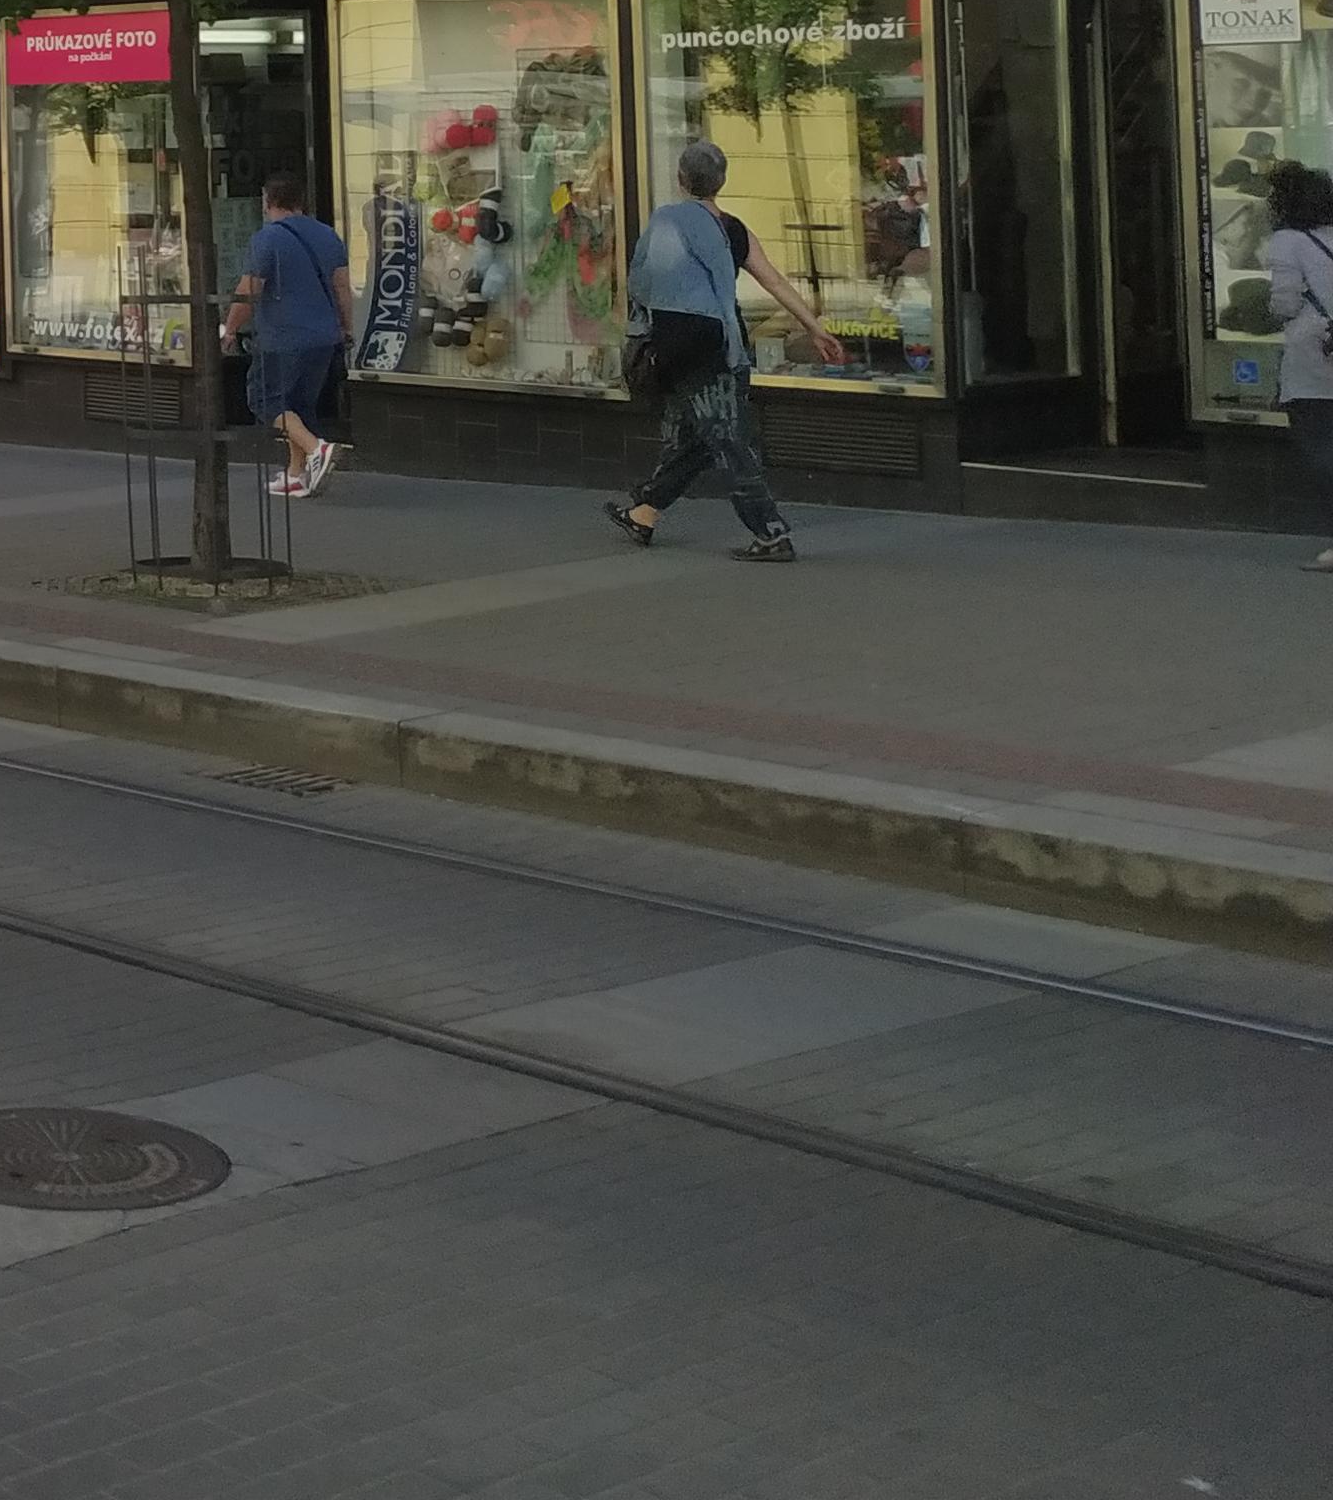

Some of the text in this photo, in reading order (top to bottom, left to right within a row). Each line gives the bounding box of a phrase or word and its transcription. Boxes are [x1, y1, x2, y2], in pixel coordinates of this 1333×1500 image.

[1205, 8, 1293, 28] TONAK
[26, 29, 156, 52] PRŮKAZOVÉ FOTO
[661, 16, 906, 52] punčochové zboží
[69, 54, 79, 62] na
[374, 154, 405, 326] MONDIAL
